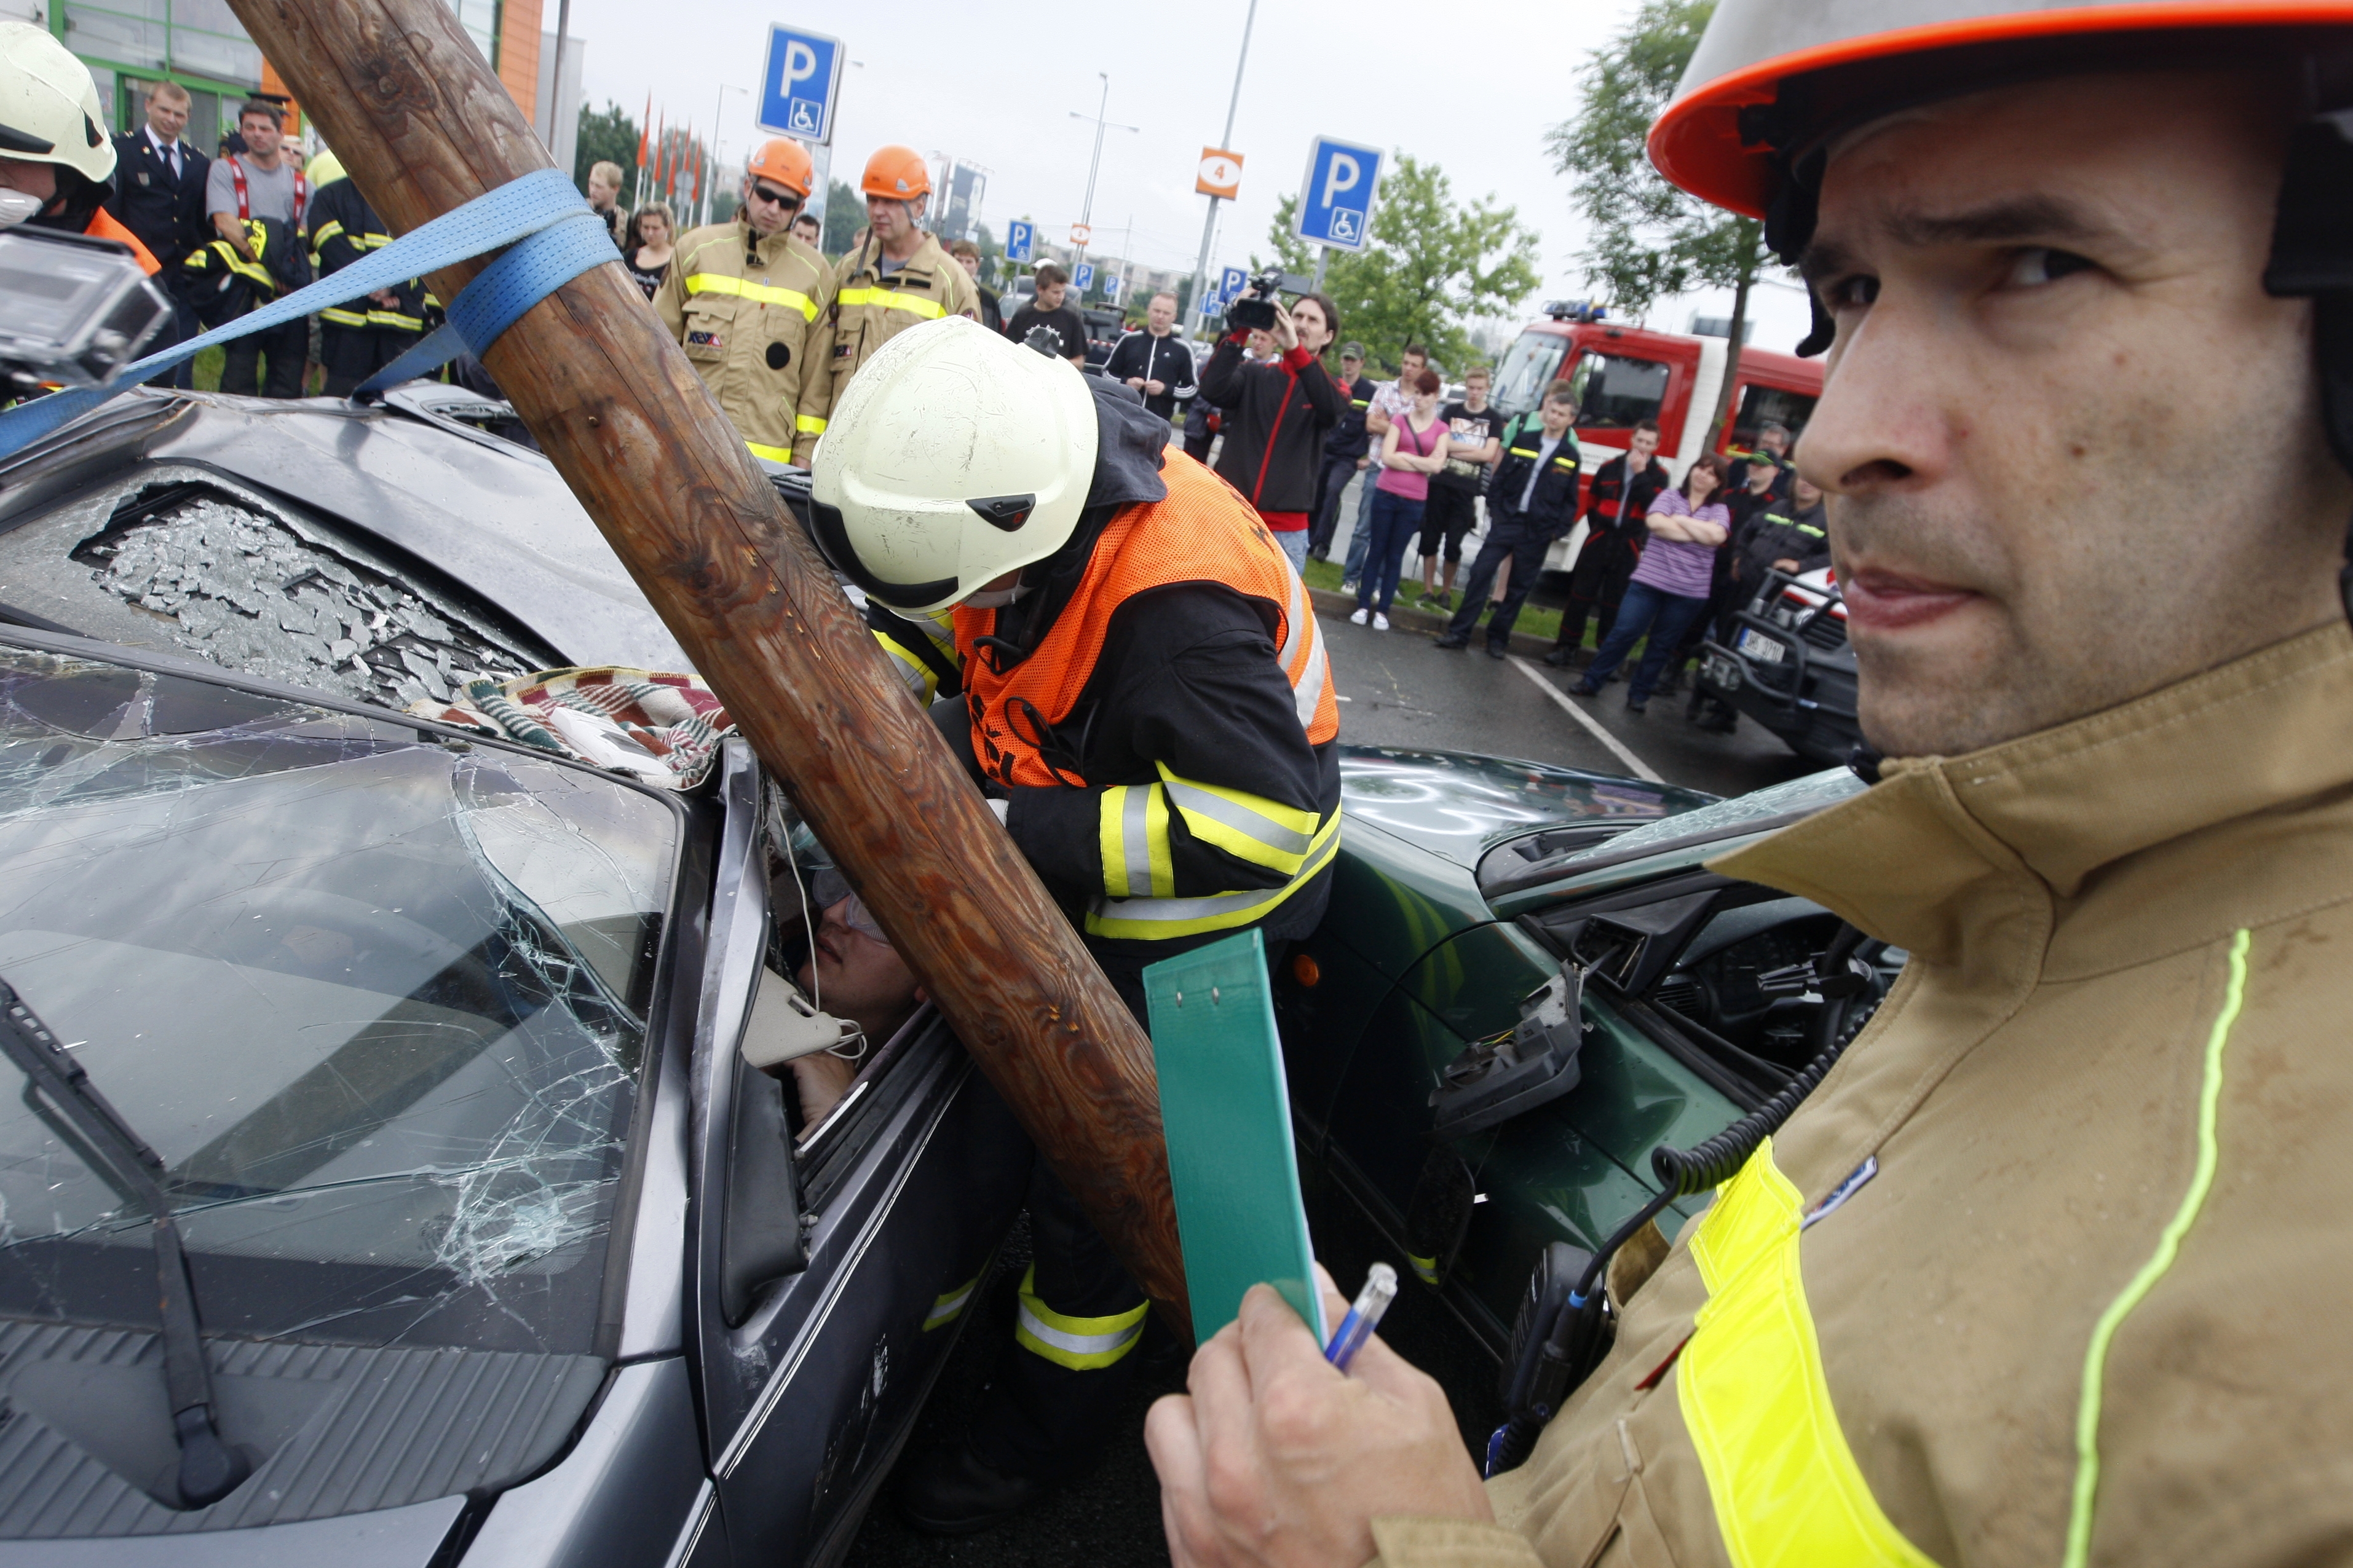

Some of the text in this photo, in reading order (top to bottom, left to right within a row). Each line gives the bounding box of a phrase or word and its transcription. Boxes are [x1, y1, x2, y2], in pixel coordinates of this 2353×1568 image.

[780, 39, 817, 99] P
[1215, 165, 1225, 179] 4
[1321, 151, 1361, 208] P
[1013, 224, 1027, 246] P
[1079, 266, 1089, 280] P
[1109, 278, 1116, 288] P
[1226, 270, 1241, 292] P
